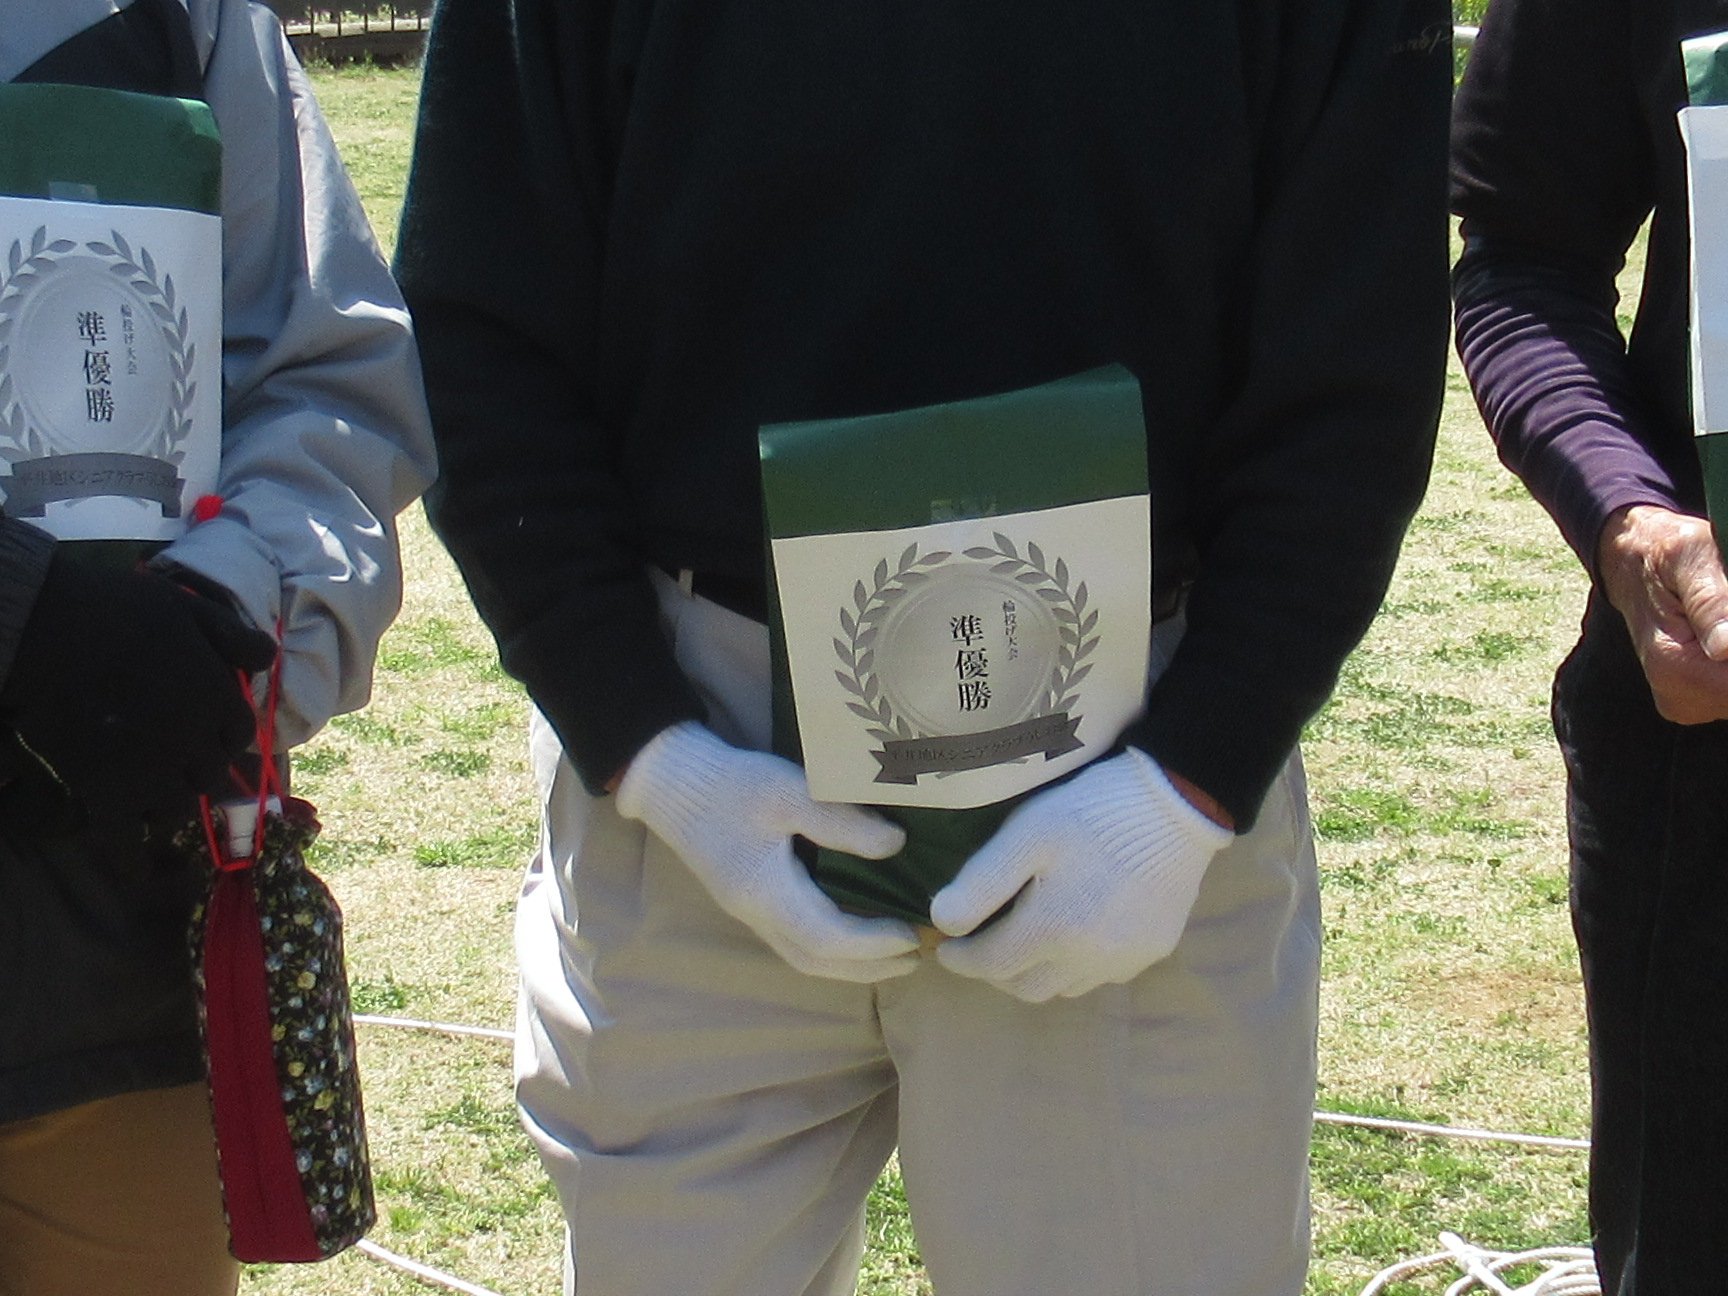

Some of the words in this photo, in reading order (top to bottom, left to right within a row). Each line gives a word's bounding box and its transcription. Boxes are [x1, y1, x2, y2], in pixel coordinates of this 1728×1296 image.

[78, 311, 115, 423] 準優勝
[950, 615, 992, 712] 準優勝
